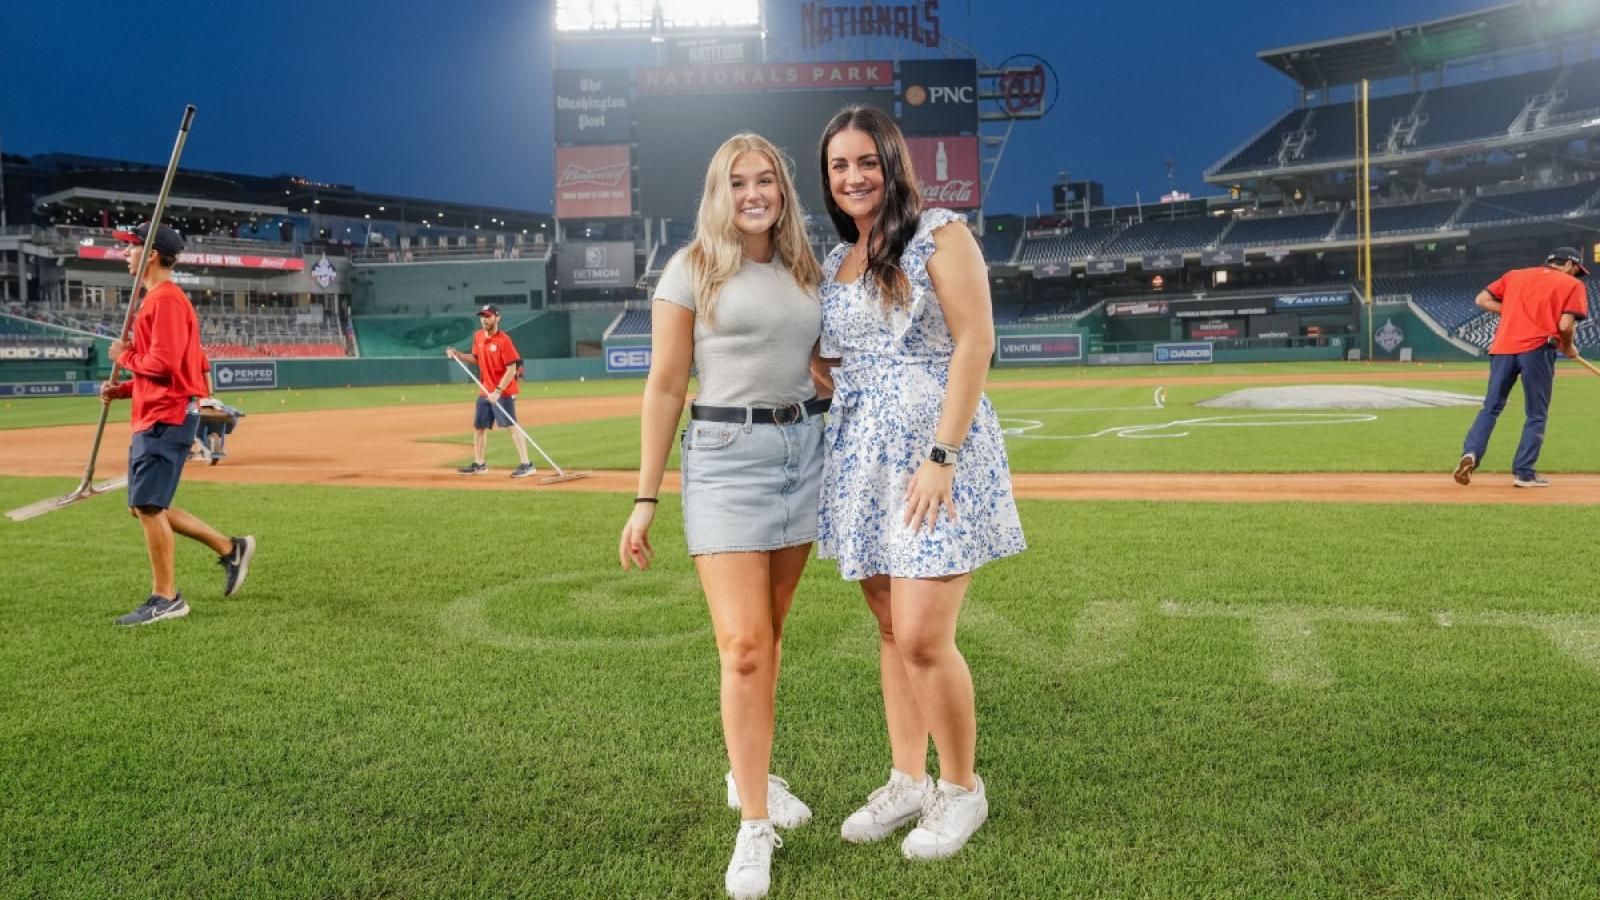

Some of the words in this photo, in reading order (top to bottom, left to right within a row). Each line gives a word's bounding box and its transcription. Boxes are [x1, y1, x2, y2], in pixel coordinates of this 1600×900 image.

[801, 0, 940, 49] NATIONALS
[646, 67, 798, 86] NATIONALS
[813, 66, 879, 81] PARK
[580, 78, 602, 93] The
[556, 94, 627, 111] Washington
[928, 86, 974, 104] PNC
[578, 114, 605, 130] Post
[573, 269, 620, 280] BETMGM
[43, 347, 82, 359] FAN
[1003, 343, 1042, 353] VENTURE
[609, 351, 650, 368] GEI
[234, 369, 273, 378] PENFED
